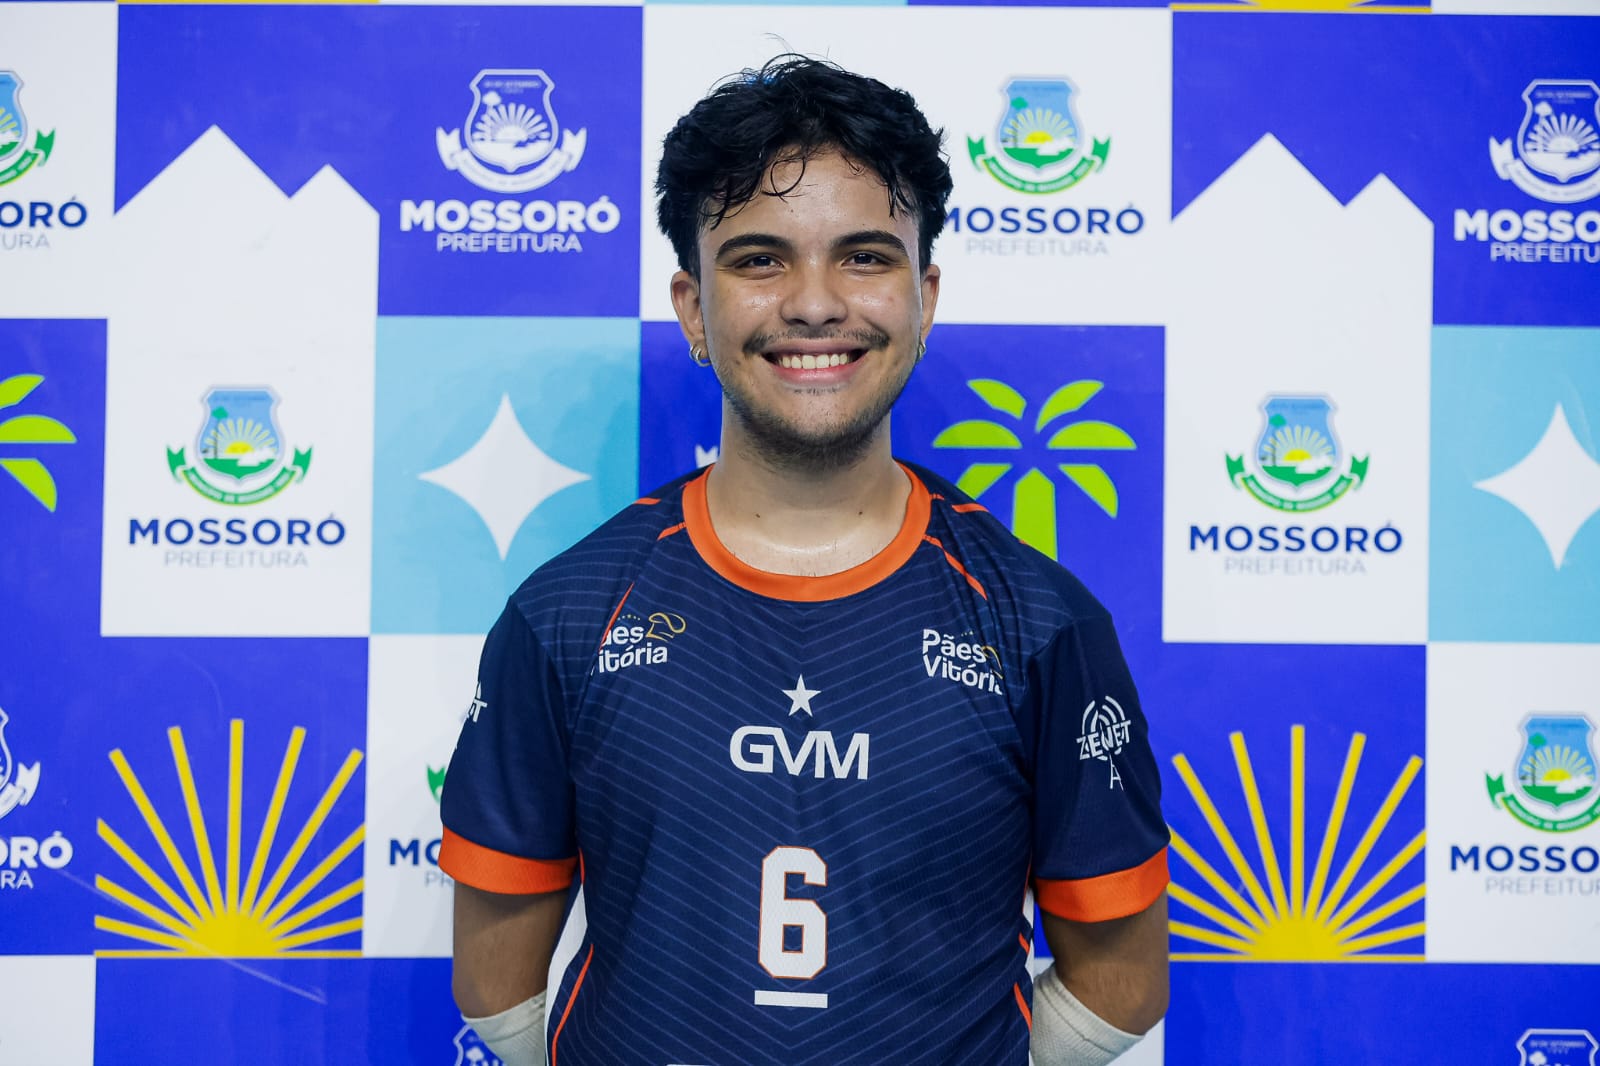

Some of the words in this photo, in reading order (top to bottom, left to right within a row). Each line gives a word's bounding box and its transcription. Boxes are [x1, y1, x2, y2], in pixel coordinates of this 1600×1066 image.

[400, 195, 621, 234] MOSSORÓ
[1454, 208, 1600, 243] MOSSO
[436, 233, 583, 252] PREFEITURA
[966, 238, 1109, 256] PREFEITURA
[1490, 242, 1600, 263] PREFEITU
[128, 513, 346, 545] MOSSORÓ
[1190, 520, 1403, 553] MOSSORÓ
[164, 550, 309, 567] PREFEITURA
[1224, 556, 1367, 575] PREFEITURA
[598, 642, 668, 673] itória
[922, 628, 987, 664] Pães
[729, 725, 870, 780] GVM
[1076, 720, 1132, 761] ZENET
[1450, 845, 1600, 874] MOSSO
[1485, 876, 1600, 896] PREFEITU
[758, 845, 828, 980] 6
